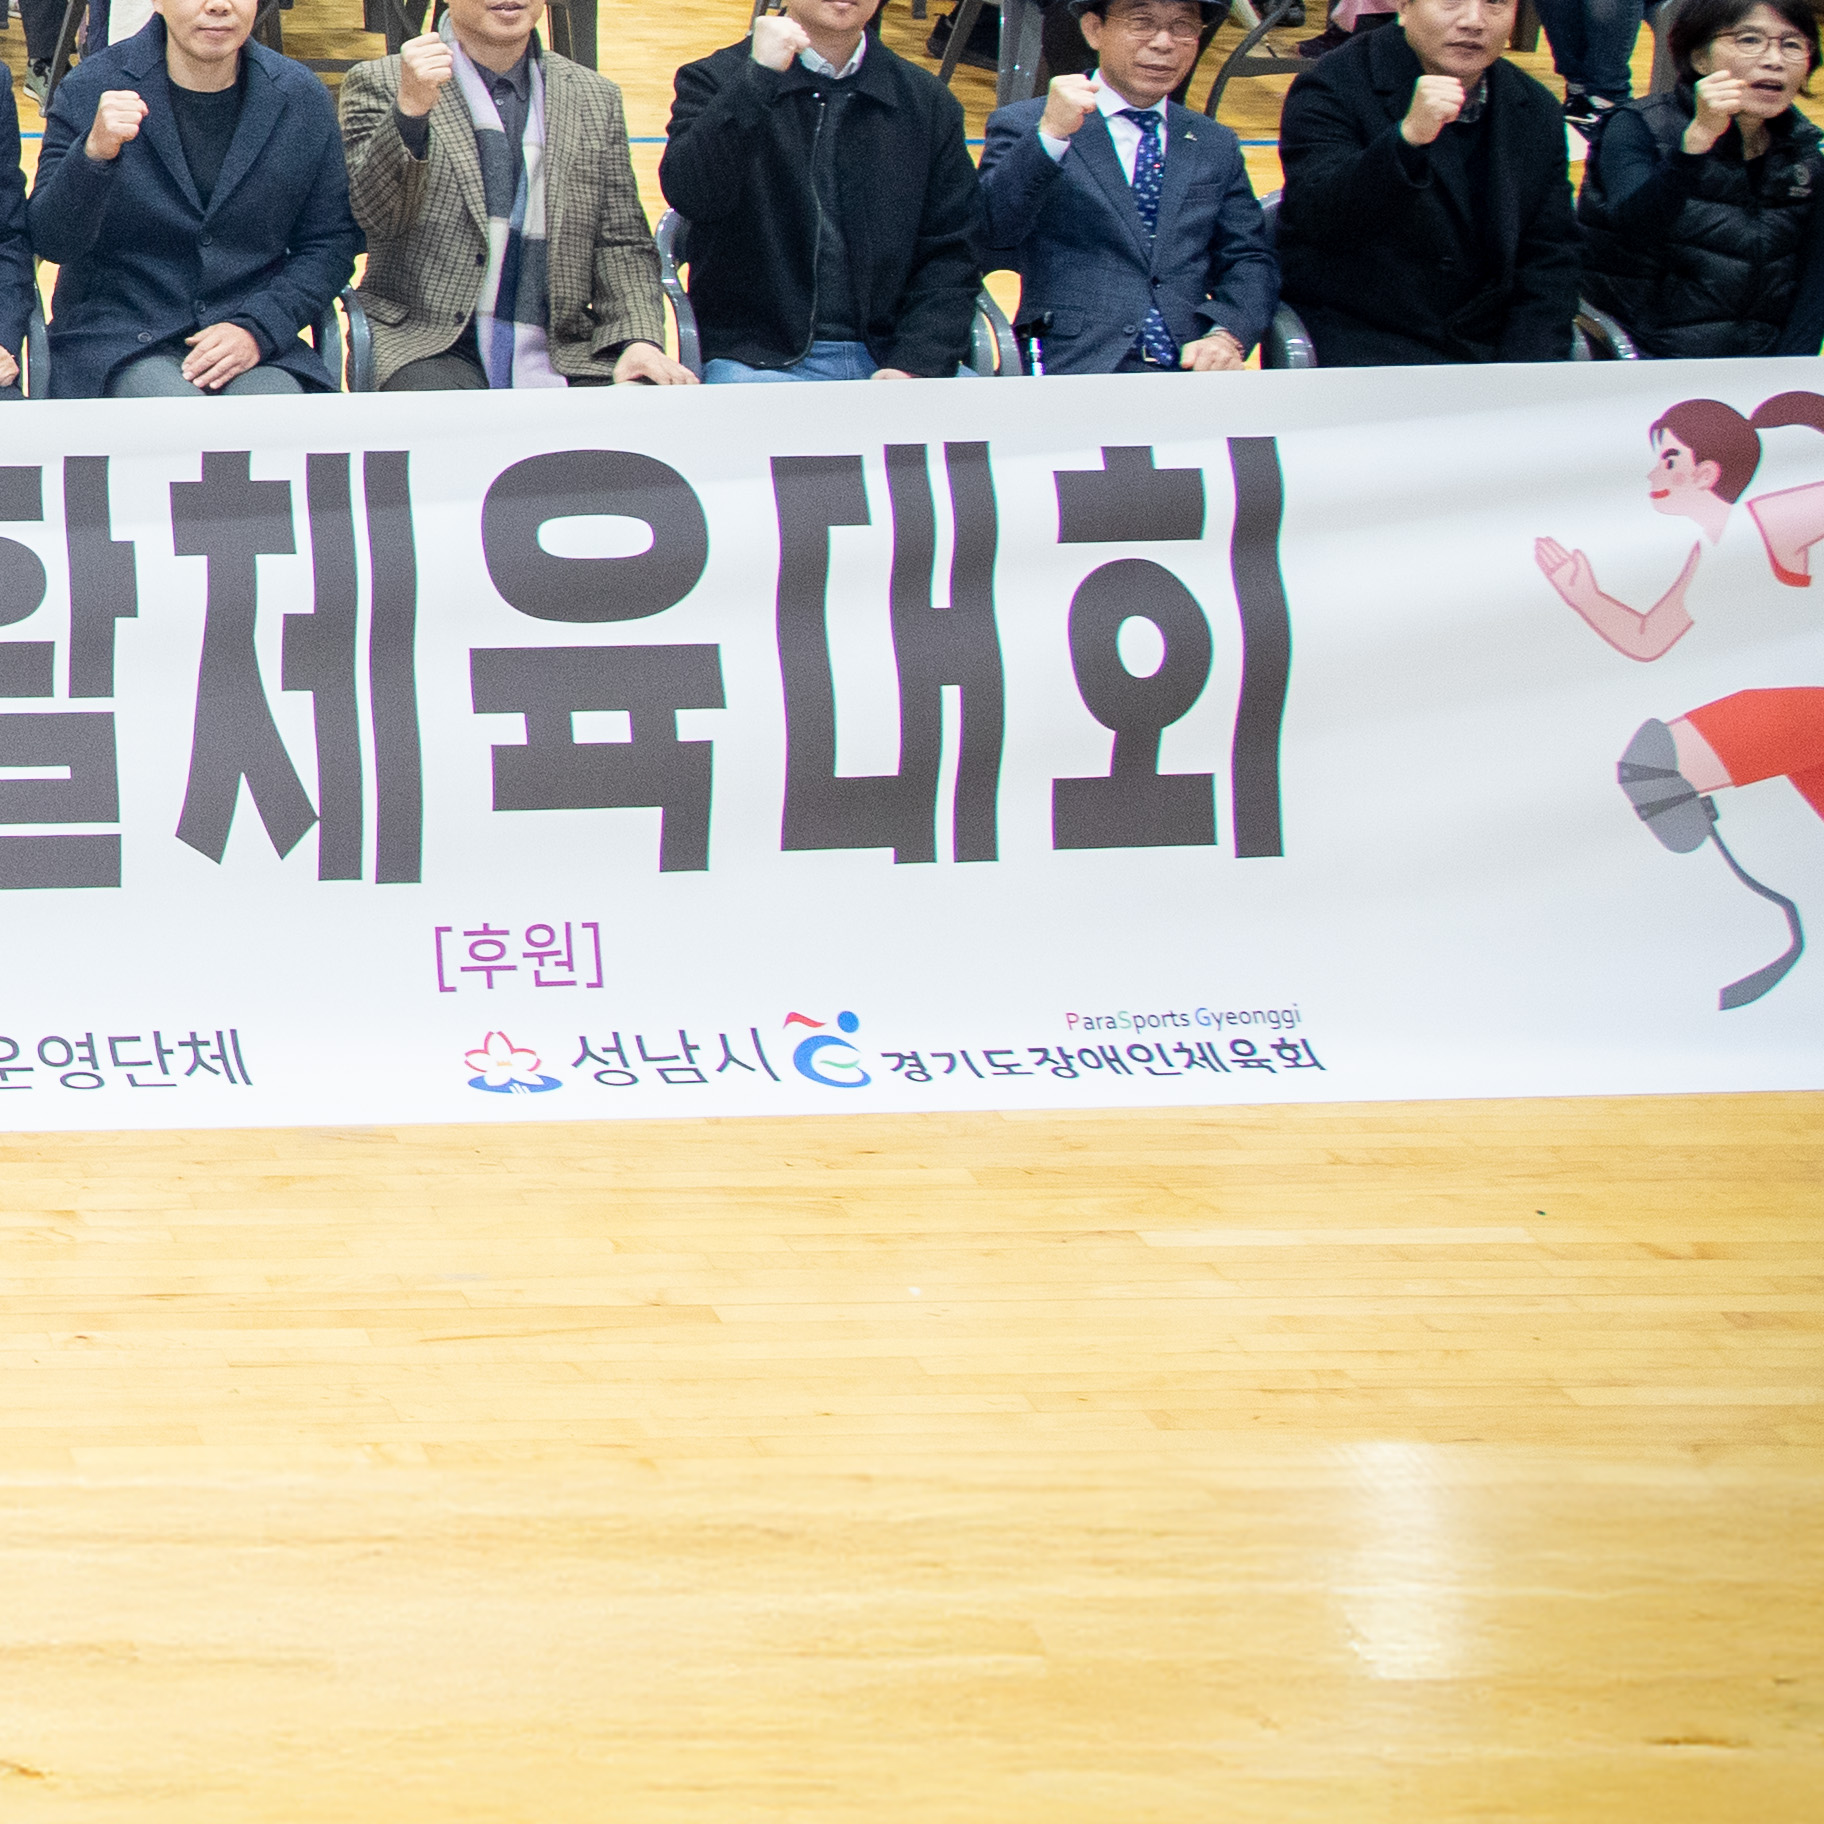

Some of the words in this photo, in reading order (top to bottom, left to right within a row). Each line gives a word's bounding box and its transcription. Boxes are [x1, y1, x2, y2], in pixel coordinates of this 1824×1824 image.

[434, 922, 604, 993] [후원]
[1065, 1008, 1191, 1035] ParaSports
[1195, 1003, 1302, 1032] Gyeonggi
[571, 1027, 782, 1087] 성남시
[881, 1035, 1327, 1083] 경기도장애인체육회
